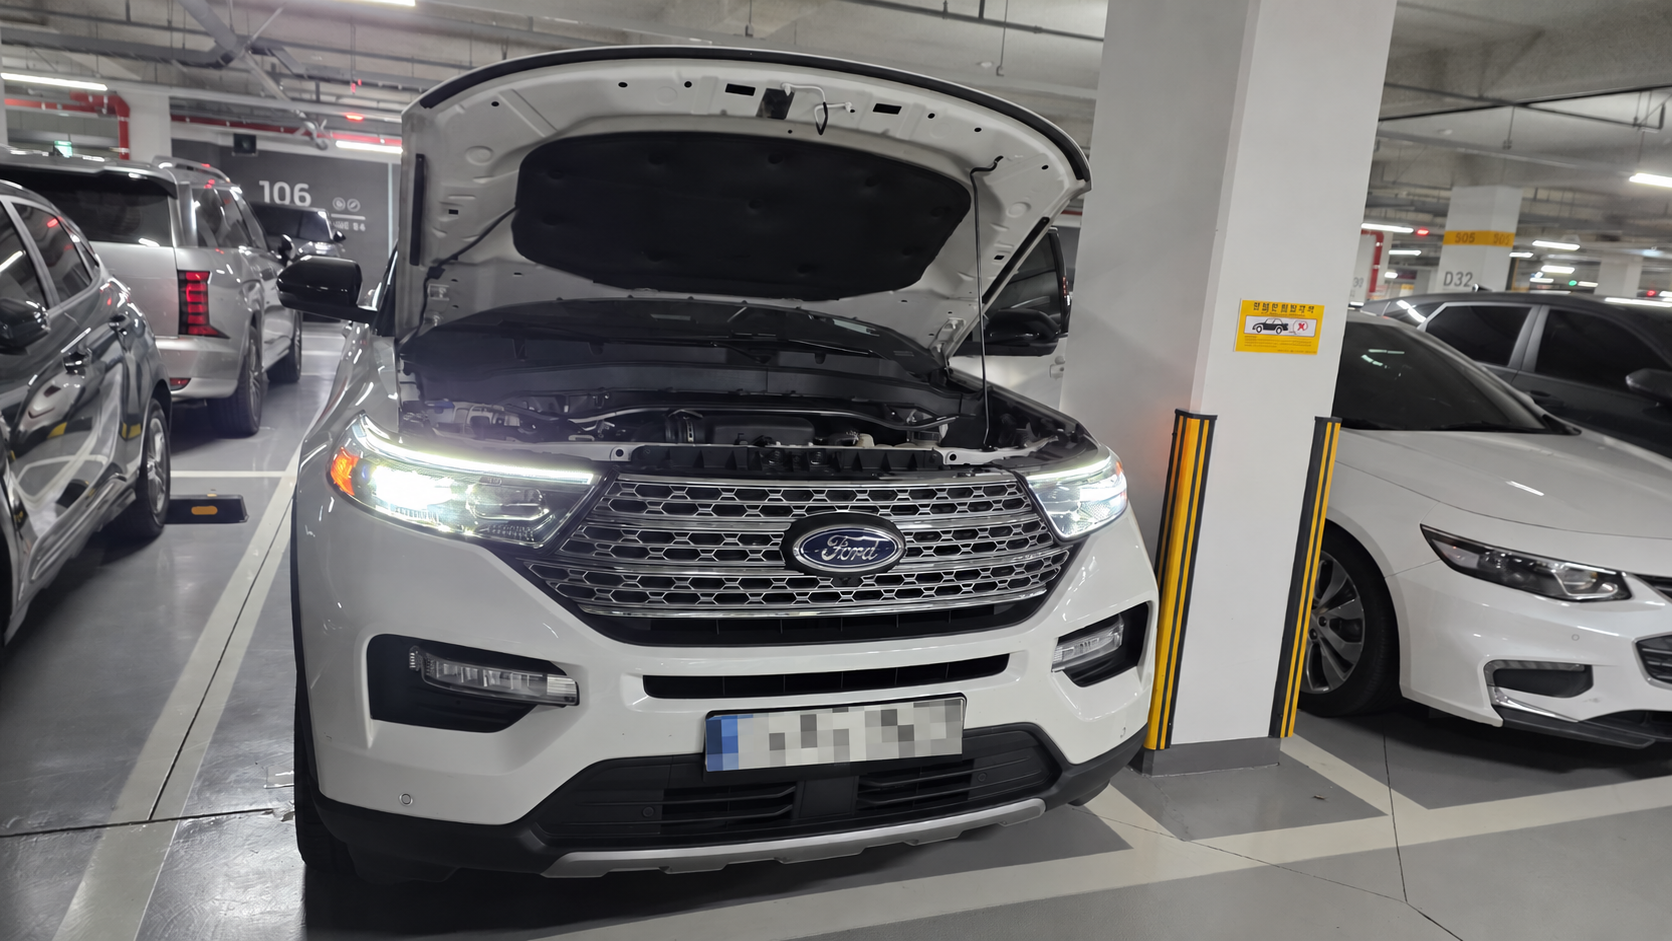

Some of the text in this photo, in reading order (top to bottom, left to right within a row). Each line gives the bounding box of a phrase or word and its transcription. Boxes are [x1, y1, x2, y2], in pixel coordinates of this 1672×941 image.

[259, 180, 312, 207] 106
[1443, 271, 1473, 288] D32
[821, 534, 890, 561] Ford
